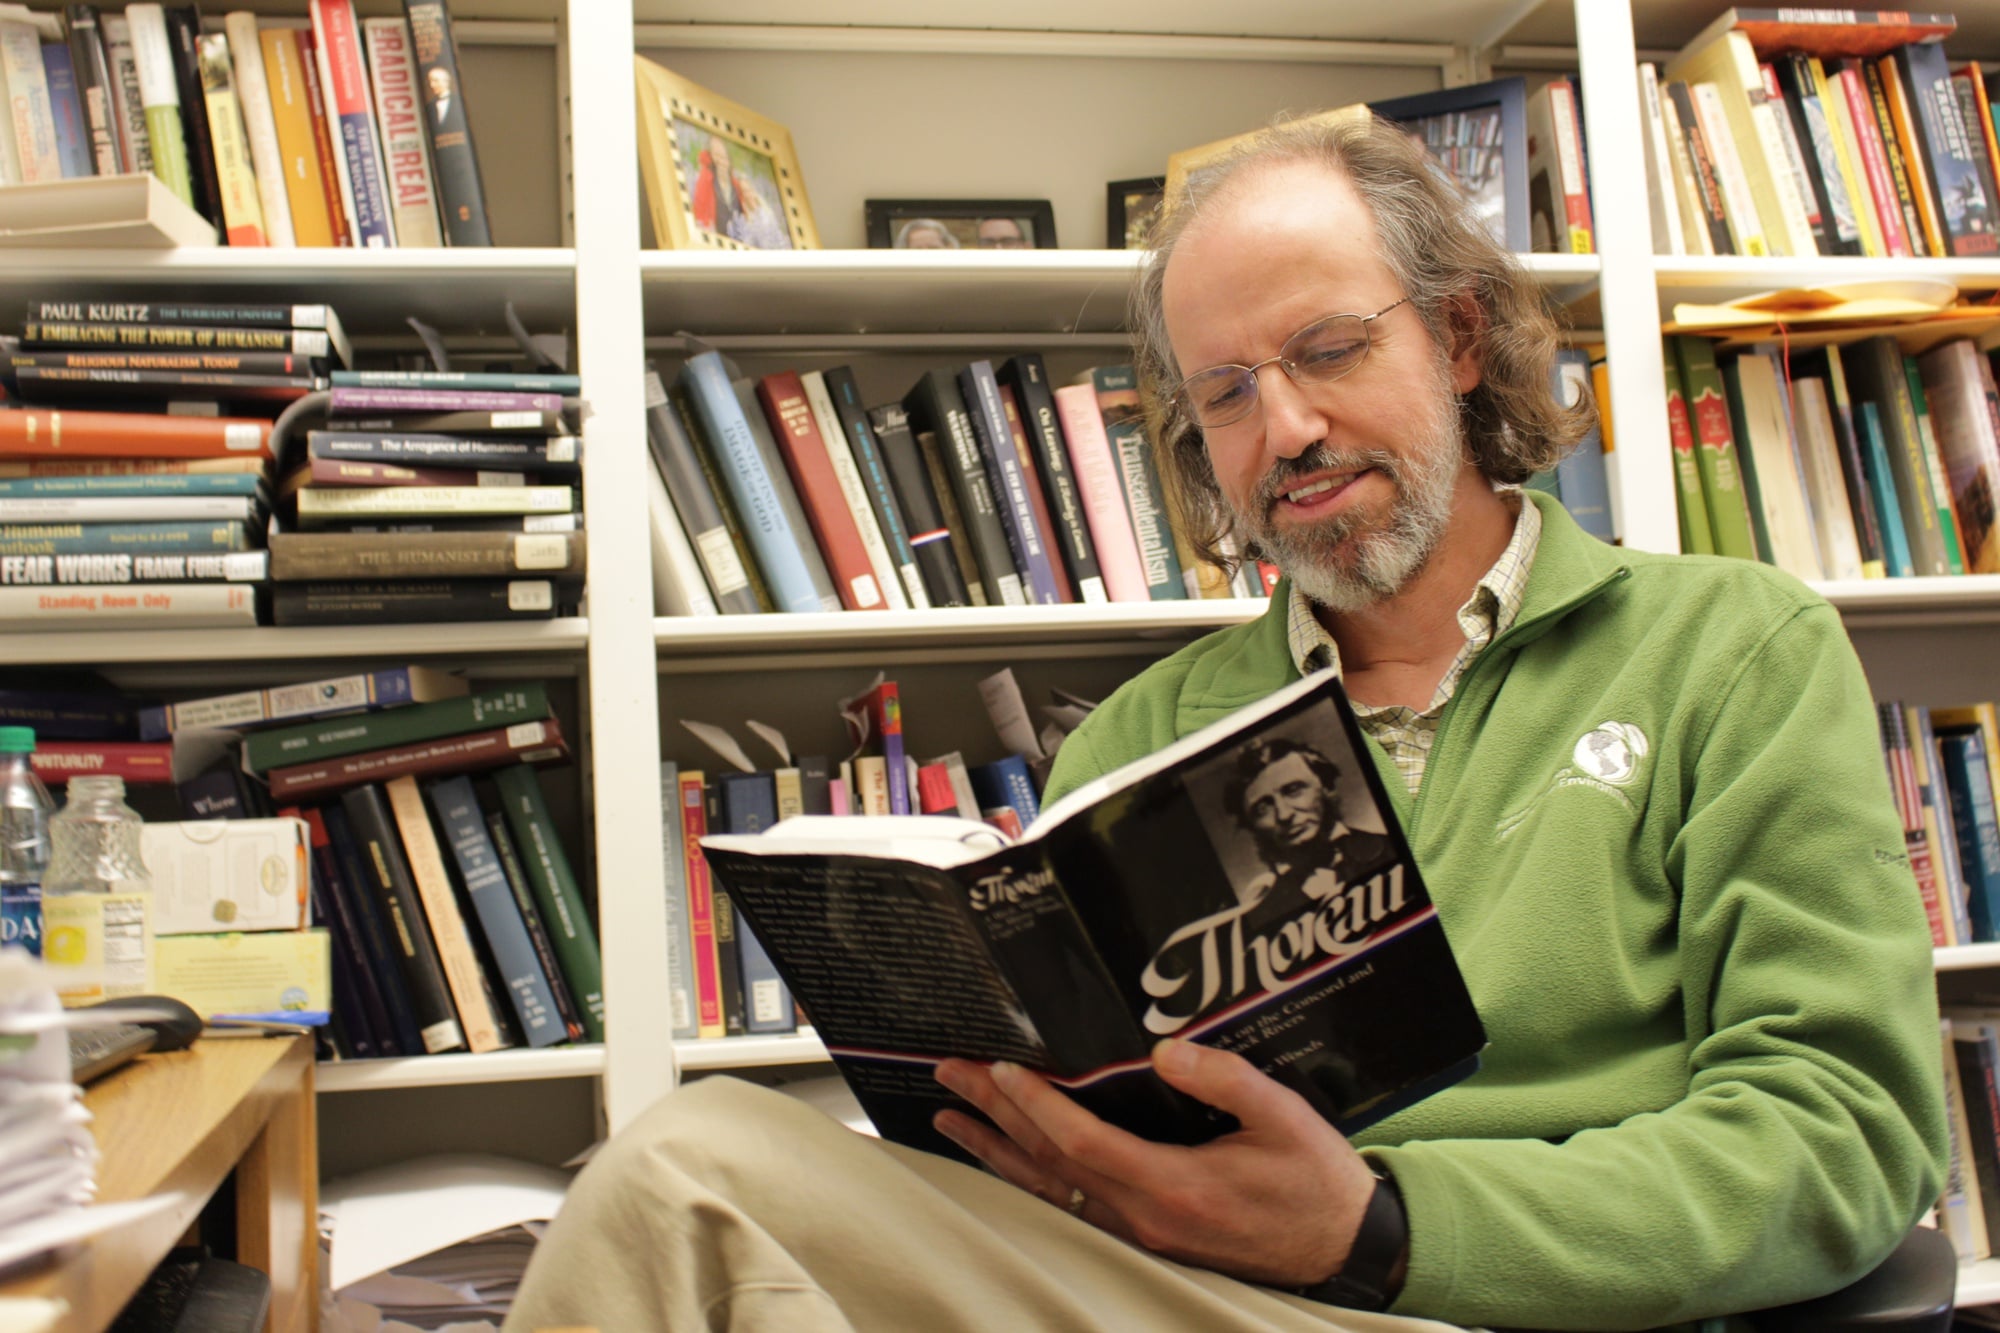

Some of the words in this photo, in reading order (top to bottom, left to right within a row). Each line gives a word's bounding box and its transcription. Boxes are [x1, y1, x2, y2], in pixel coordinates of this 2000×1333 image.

[374, 34, 419, 140] RADICAL
[342, 122, 355, 141] OF
[355, 126, 372, 155] THE
[346, 144, 371, 227] DEMOCRACY
[362, 157, 383, 221] RELIGION
[41, 304, 83, 321] PAUL
[88, 304, 149, 322] KURTZ
[42, 323, 116, 343] EMBRACING
[119, 327, 146, 345] THE
[150, 328, 193, 346] POWER
[216, 330, 285, 349] HUMANISM
[89, 369, 140, 382] NATURE
[1036, 405, 1053, 426] On
[381, 439, 401, 452] The
[404, 440, 459, 454] Arrogance
[459, 440, 470, 452] of
[472, 441, 527, 453] Humanism
[733, 418, 776, 509] IDENTIFYING
[1002, 458, 1016, 473] THE
[723, 425, 752, 480] IMAGE
[750, 496, 773, 533] GOD
[1006, 471, 1021, 488] PEN
[1011, 487, 1025, 503] AND
[1015, 502, 1029, 516] THE
[1119, 432, 1171, 586] Transcendentalism
[5, 524, 83, 539] Humanist
[854, 505, 880, 546] Politics
[1018, 515, 1036, 540] PICKET
[0, 541, 56, 554] utlook
[358, 552, 392, 566] THE
[398, 550, 481, 564] HUMANIST
[487, 549, 516, 562] FRA
[1026, 538, 1041, 556] LINE
[3, 555, 53, 583] FEAR
[57, 555, 132, 583] WORKS
[135, 556, 185, 579] FRANK
[39, 595, 96, 610] Standing
[102, 595, 137, 607] Room
[144, 593, 171, 608] Only
[873, 768, 884, 792] The
[1140, 863, 1407, 1036] Thoreau
[1235, 1024, 1255, 1039] on
[1256, 1012, 1280, 1028] the
[1282, 977, 1346, 1015] Concord
[1347, 962, 1375, 984] and
[1261, 1014, 1306, 1039] Rivers
